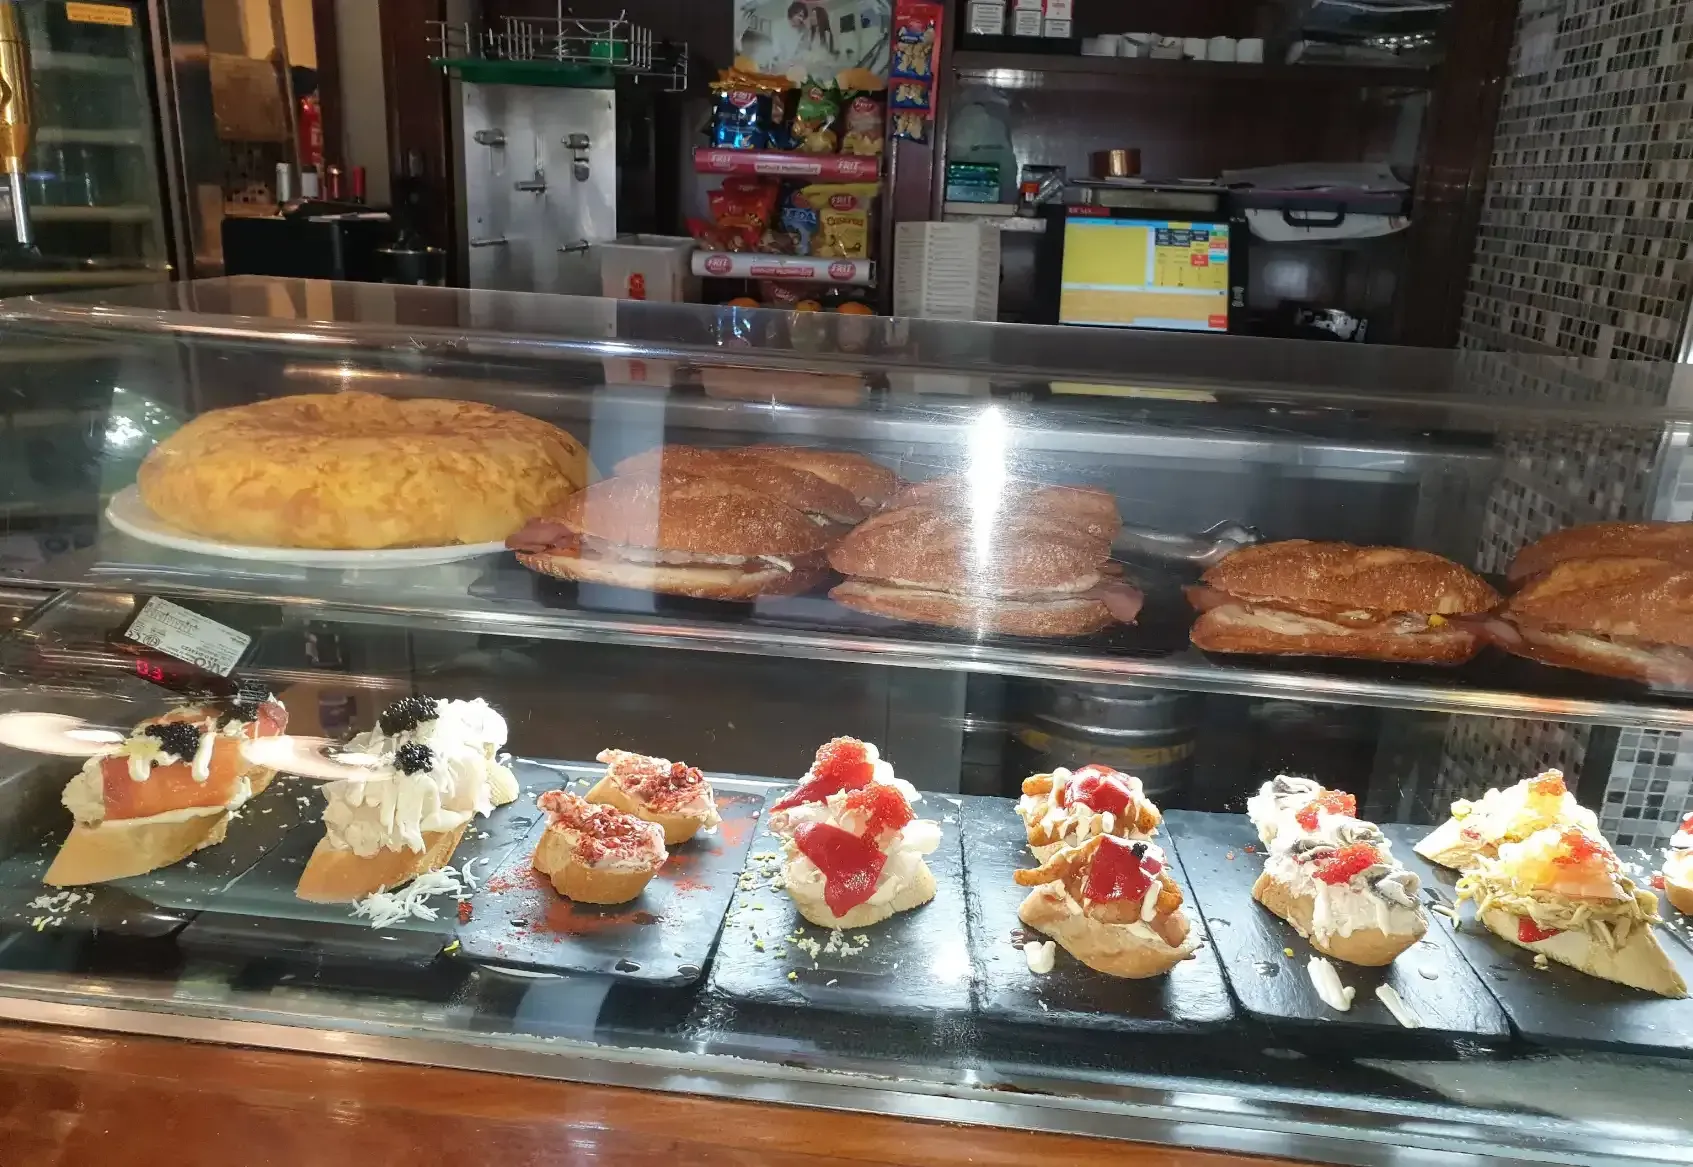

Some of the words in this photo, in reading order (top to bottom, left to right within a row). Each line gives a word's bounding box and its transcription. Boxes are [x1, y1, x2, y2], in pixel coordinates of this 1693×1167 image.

[837, 160, 861, 171] FRIT
[831, 195, 854, 206] FRIT
[707, 258, 730, 268] FRIT
[830, 263, 854, 273] FRIT
